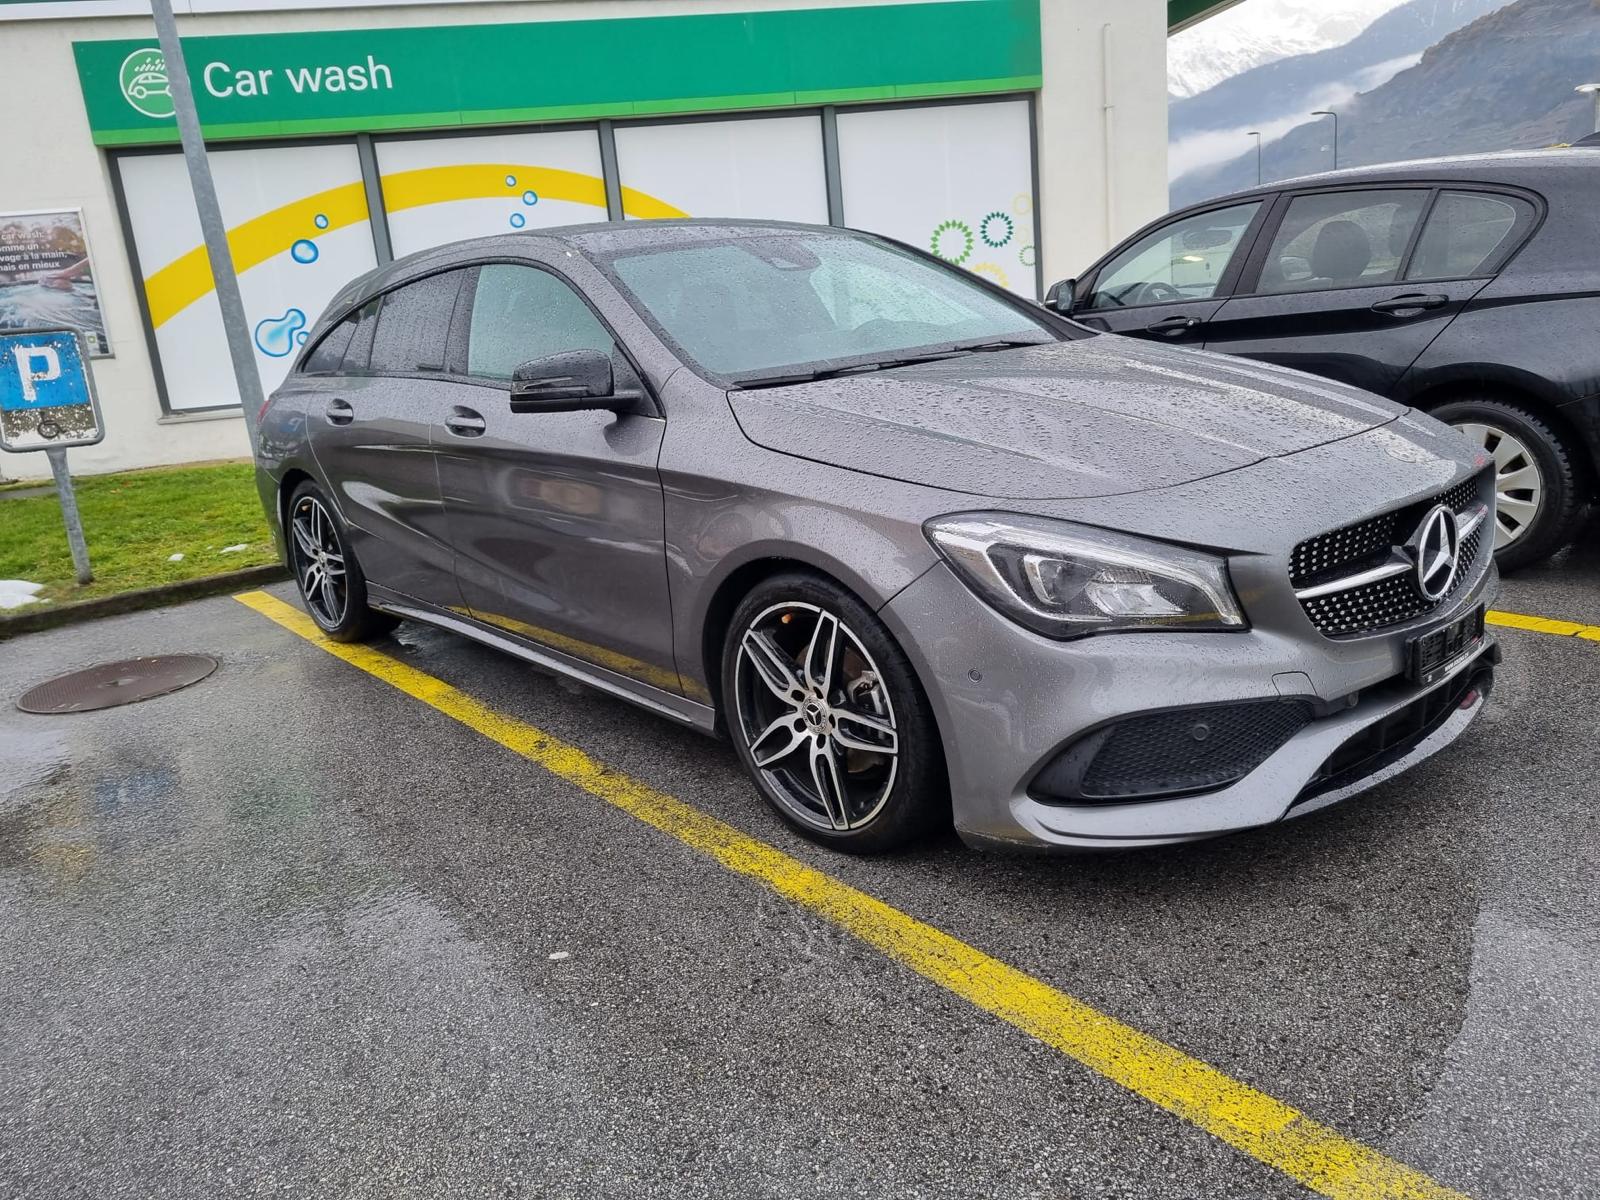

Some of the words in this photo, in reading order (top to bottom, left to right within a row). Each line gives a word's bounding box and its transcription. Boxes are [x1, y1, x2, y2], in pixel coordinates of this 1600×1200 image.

[203, 62, 273, 97] Car
[285, 55, 393, 93] wash
[30, 252, 40, 260] la
[41, 250, 68, 259] main,
[32, 260, 61, 270] mieux
[14, 344, 61, 402] P
